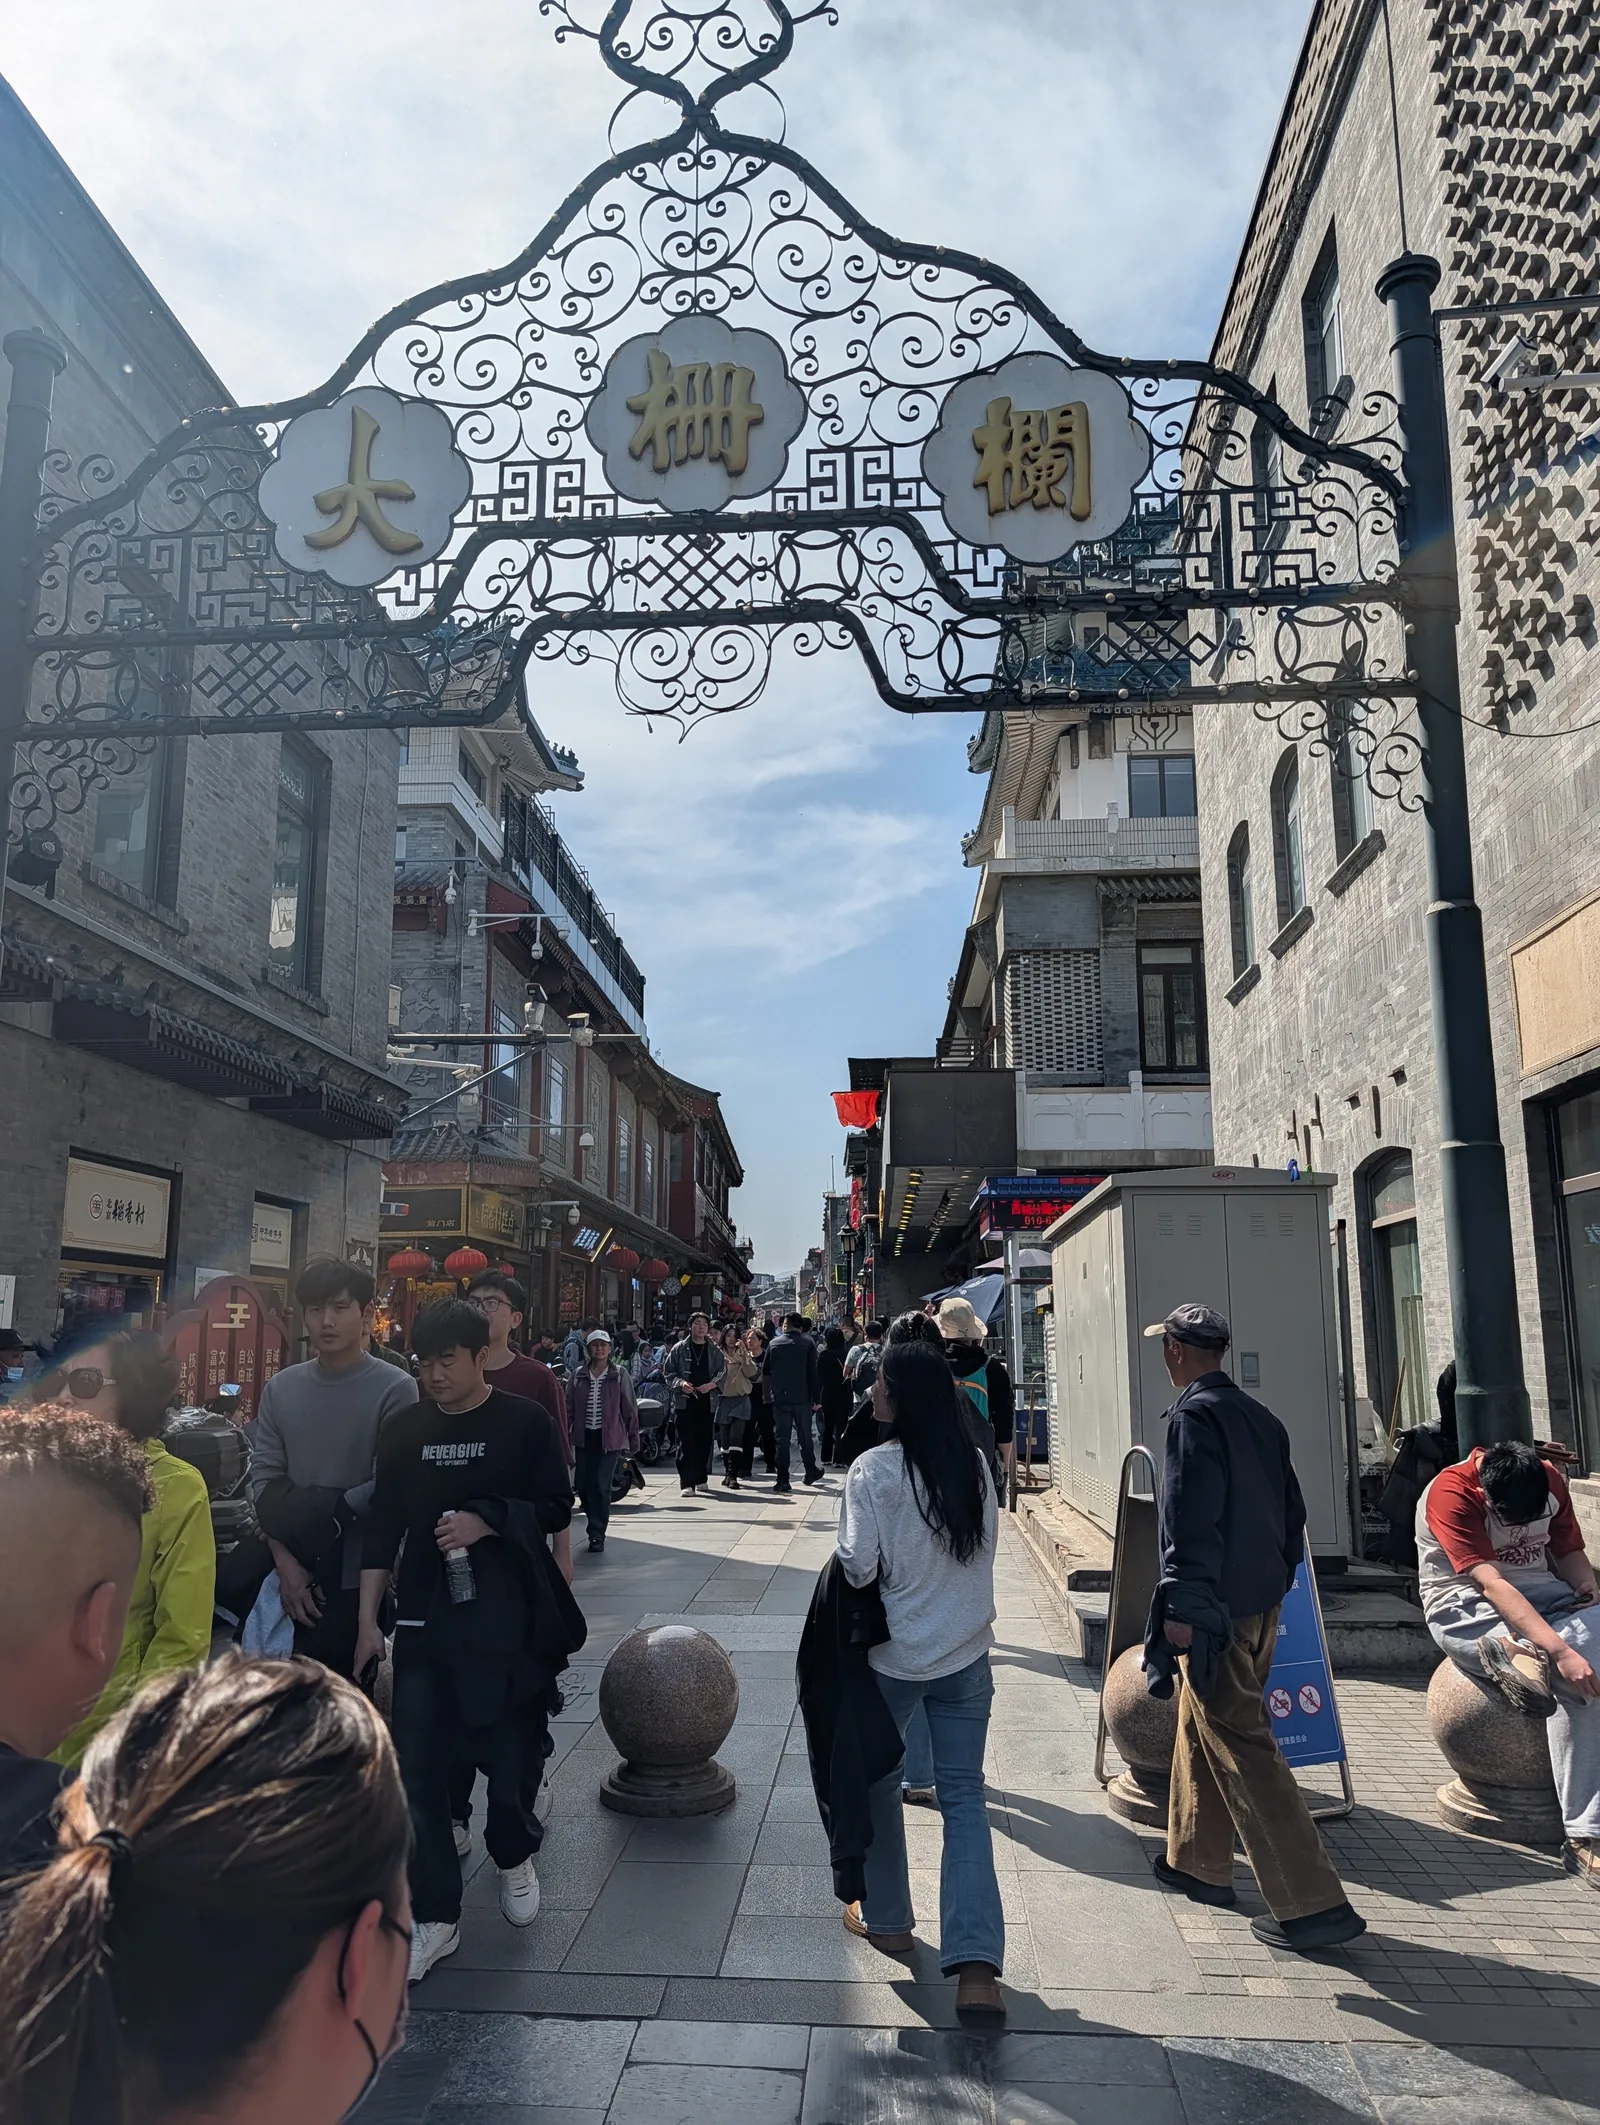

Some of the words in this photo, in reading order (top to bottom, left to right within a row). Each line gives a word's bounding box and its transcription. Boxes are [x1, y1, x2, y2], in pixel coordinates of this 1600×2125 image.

[1011, 1202, 1073, 1216] 西城分大
[218, 1349, 227, 1383] 文明
[238, 1349, 246, 1383] 自由
[246, 1349, 254, 1383] 公正
[1276, 1624, 1287, 1636] 道
